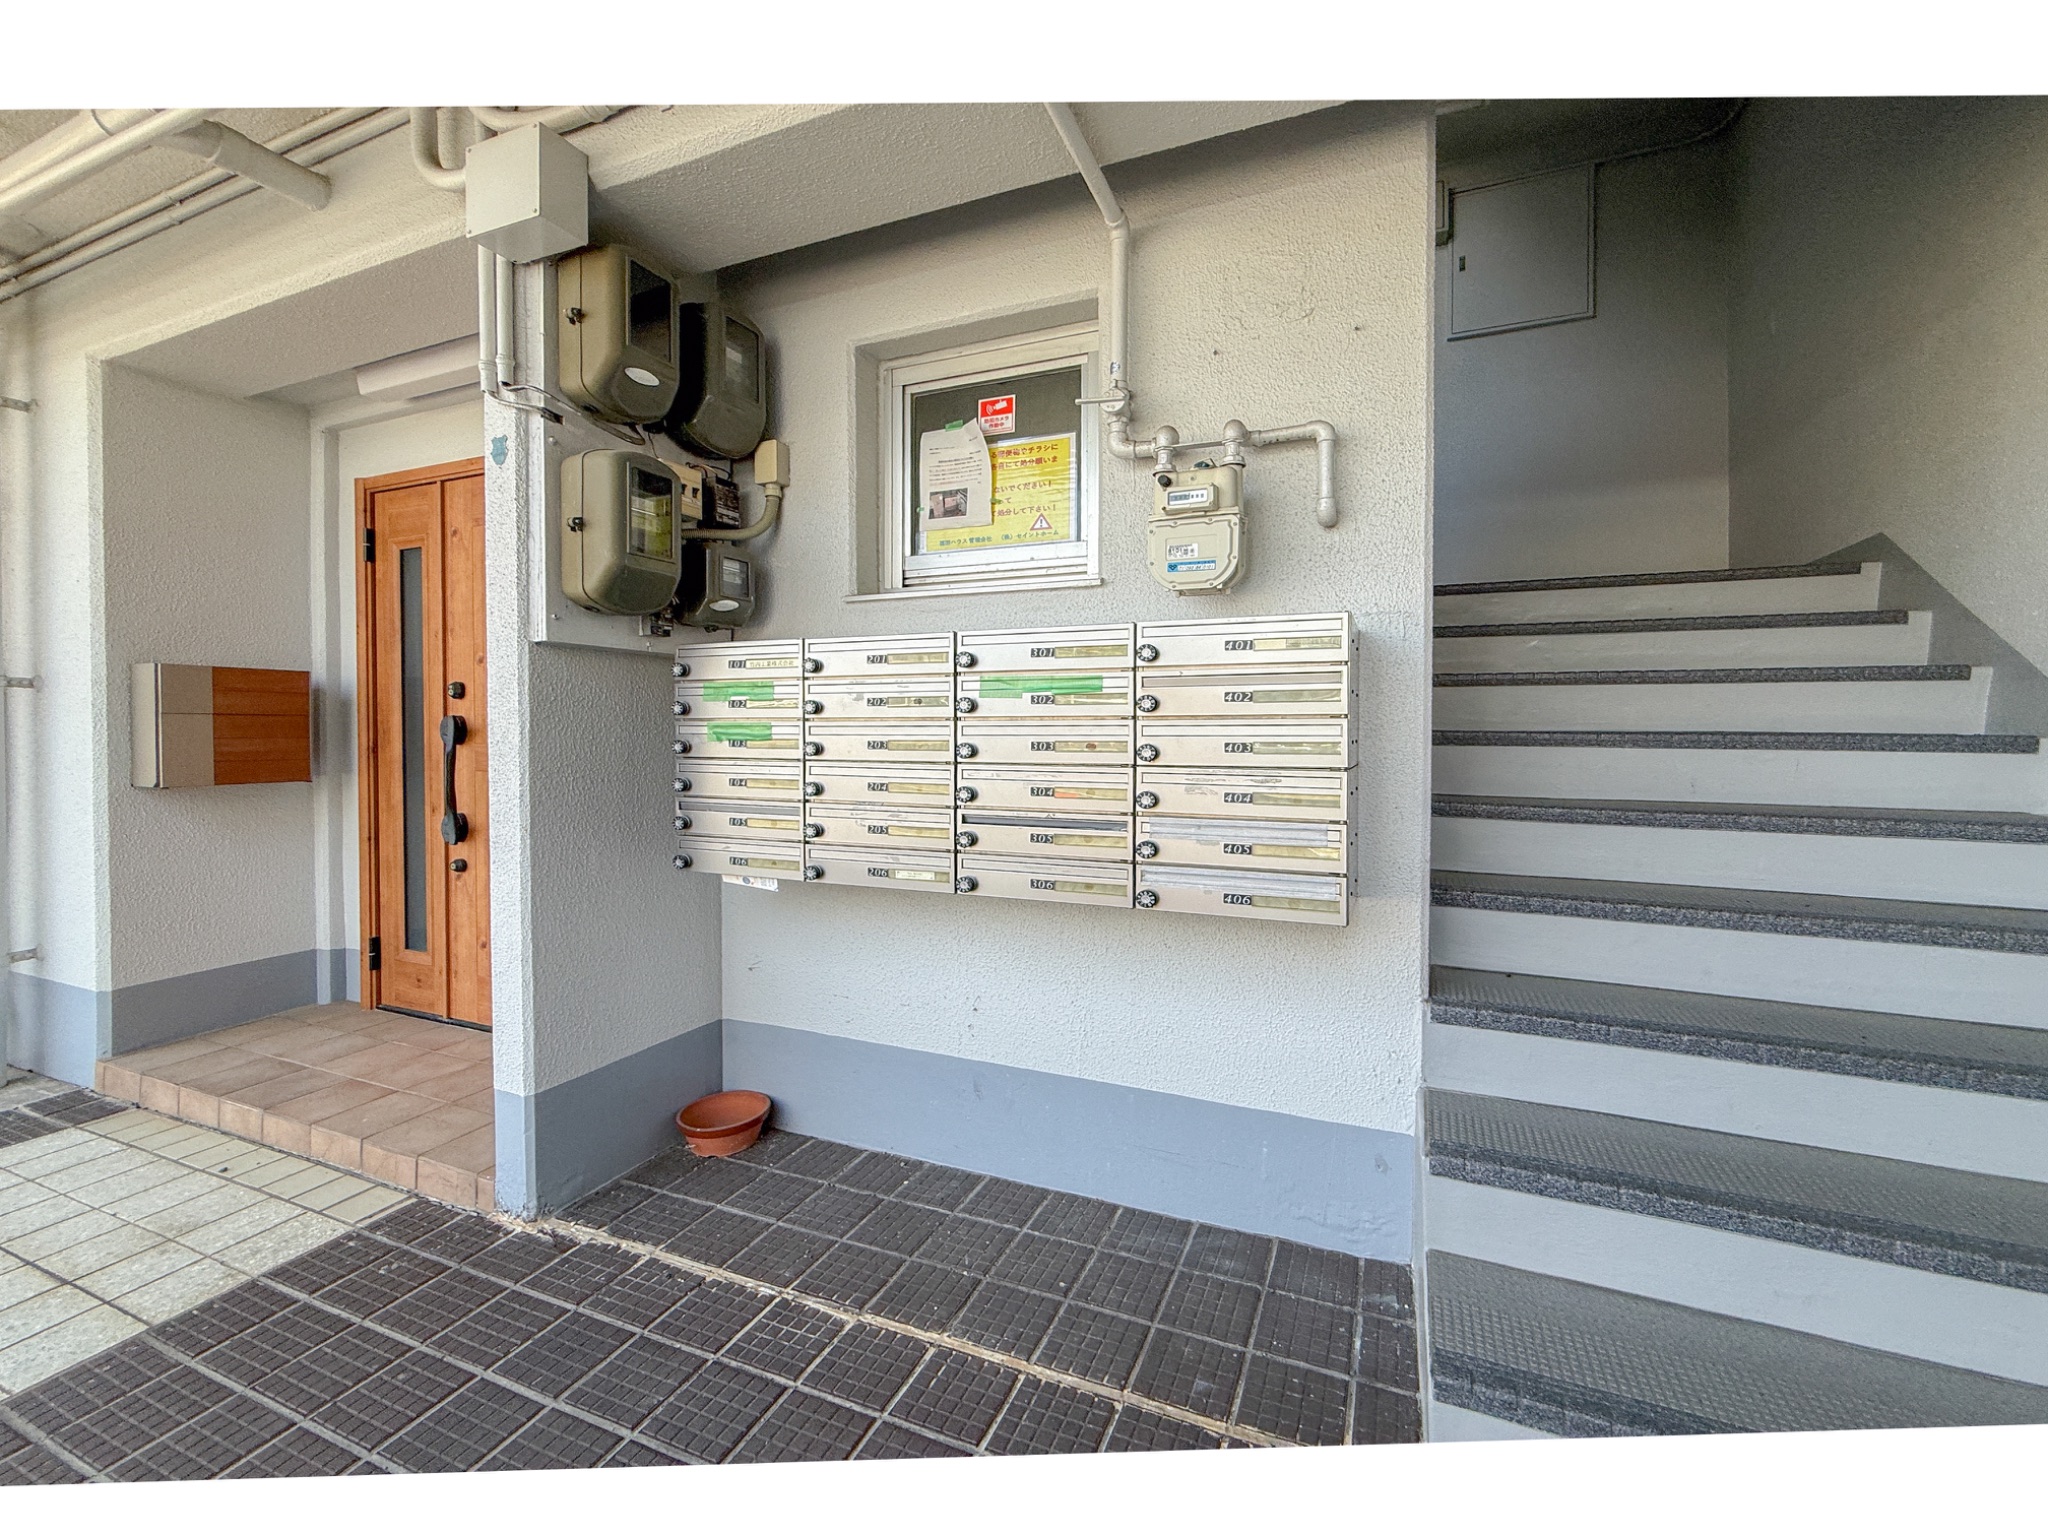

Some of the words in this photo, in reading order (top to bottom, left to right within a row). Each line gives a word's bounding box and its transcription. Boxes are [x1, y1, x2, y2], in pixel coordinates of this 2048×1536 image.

[1225, 641, 1251, 650] 401
[1031, 648, 1053, 657] 301
[729, 660, 745, 668] 101
[868, 655, 886, 664] 201
[1031, 695, 1053, 704] 302
[1224, 692, 1251, 702] 402
[729, 700, 745, 708] 102
[868, 698, 886, 706] 202
[868, 741, 887, 749] 203
[1031, 742, 1053, 751] 303
[1224, 743, 1252, 752] 403
[729, 778, 746, 786] 104
[868, 783, 887, 791] 204
[1031, 787, 1053, 796] 304
[1224, 793, 1251, 803] 404
[729, 818, 746, 826] 105
[868, 825, 887, 834] 205
[1030, 834, 1053, 843] 305
[1224, 844, 1251, 855] 405
[730, 857, 747, 866] 106
[868, 868, 887, 877] 206
[1031, 879, 1053, 889] 306
[1224, 894, 1251, 905] 406
